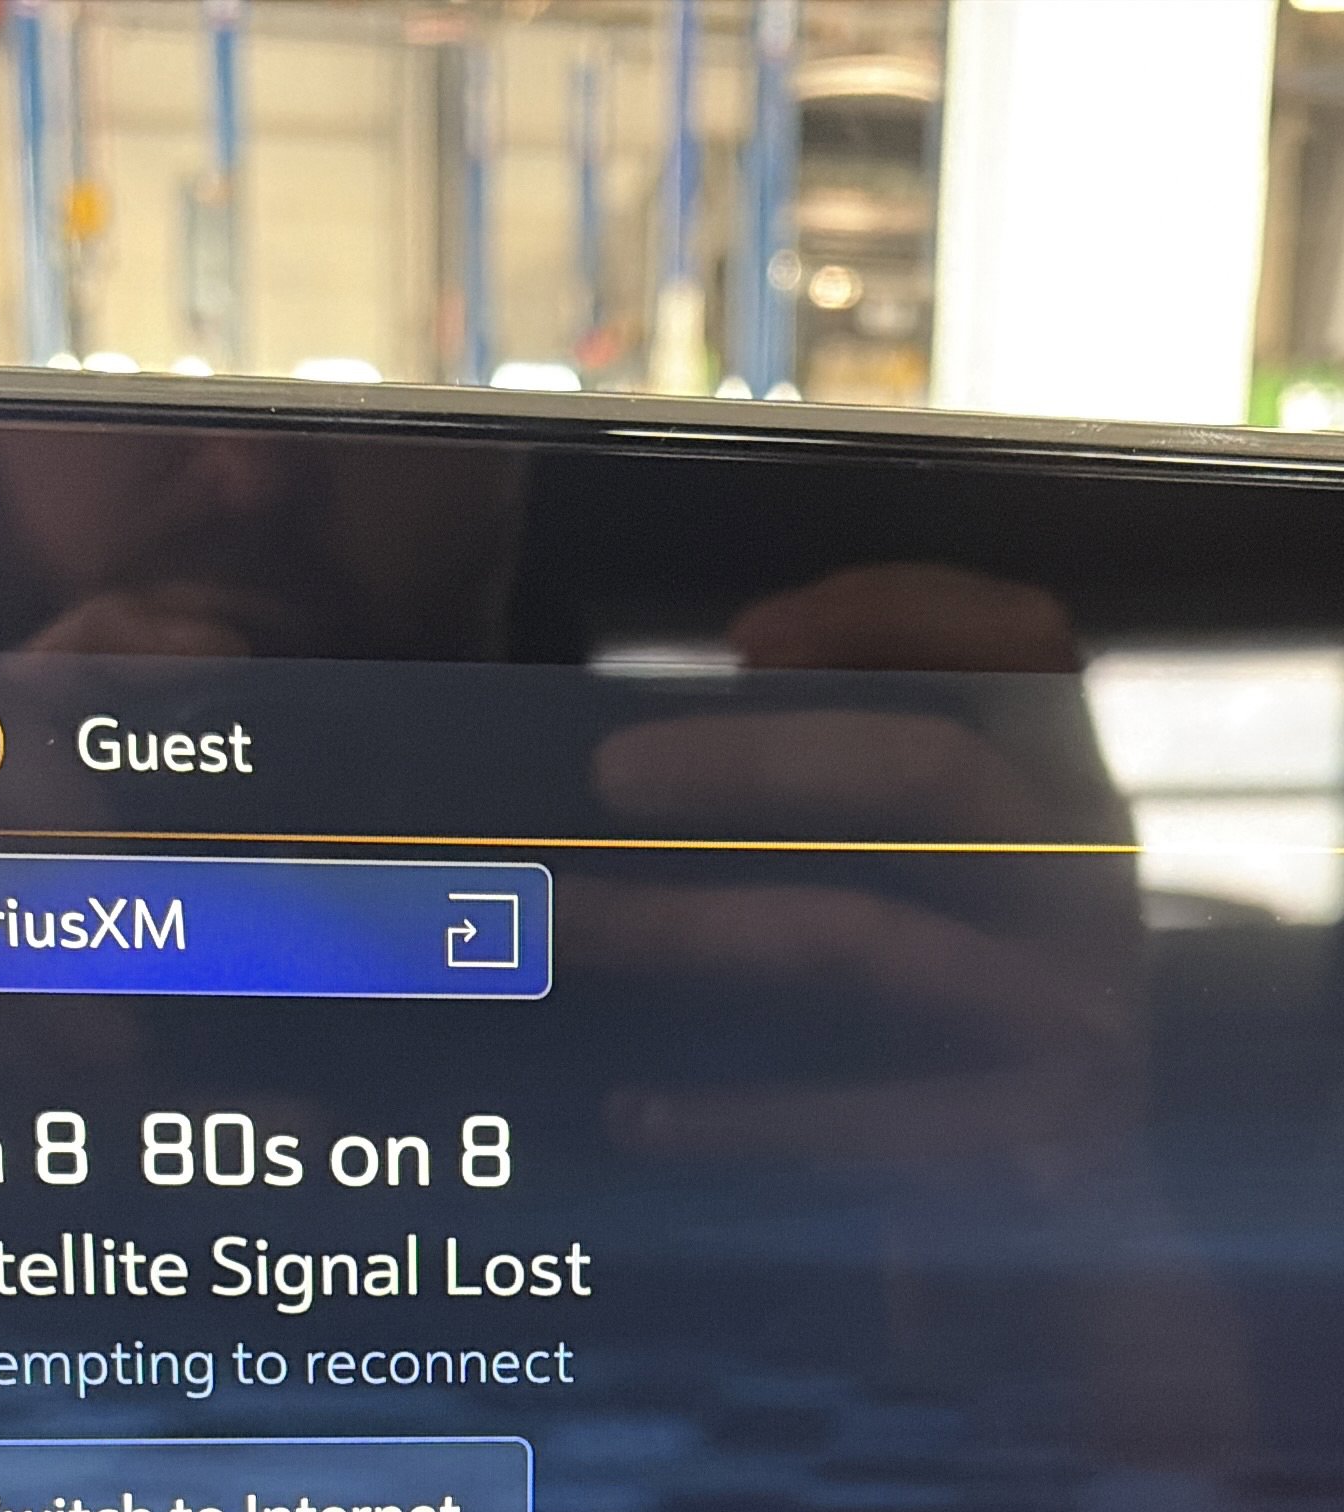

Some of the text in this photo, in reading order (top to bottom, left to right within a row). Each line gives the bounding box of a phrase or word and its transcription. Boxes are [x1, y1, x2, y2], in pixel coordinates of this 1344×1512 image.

[77, 715, 254, 774] Guest
[35, 1110, 89, 1186] 8
[142, 1111, 304, 1188] 80s
[329, 1134, 431, 1188] on
[460, 1114, 512, 1188] 8
[210, 1232, 419, 1315] Signal
[446, 1236, 593, 1298] Lost
[230, 1341, 288, 1386] to
[306, 1340, 575, 1386] reconnect
